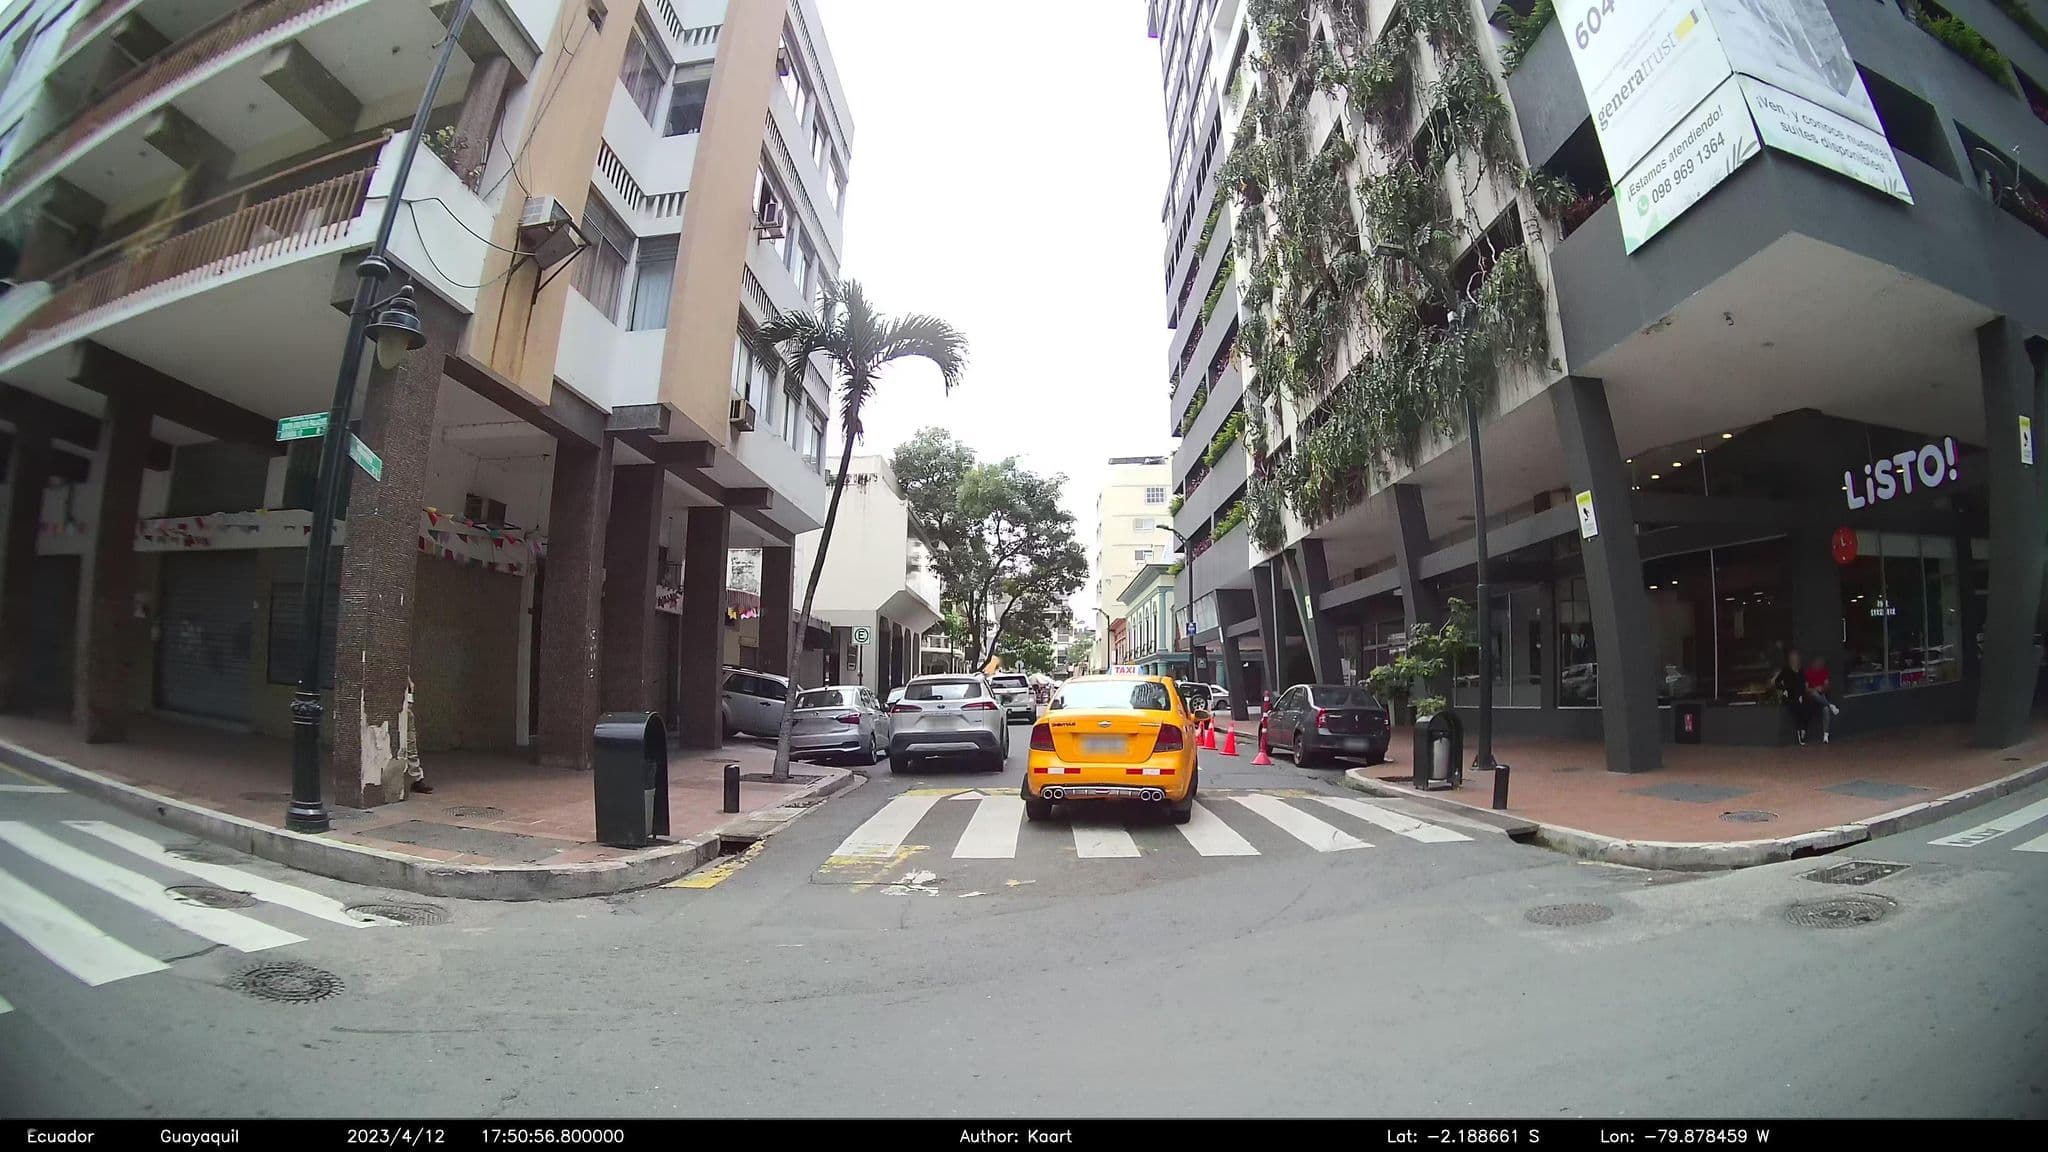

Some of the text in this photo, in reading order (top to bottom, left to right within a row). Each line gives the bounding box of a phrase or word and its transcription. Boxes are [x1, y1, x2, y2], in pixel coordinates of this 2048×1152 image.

[1598, 31, 1678, 132] generatrust
[1780, 122, 1819, 144] suites
[1792, 112, 1799, 123] y
[1802, 114, 1845, 140] conoce
[1627, 104, 1724, 203] ¡Estamos atendiendo!
[1651, 131, 1725, 204] 098 969 1364
[1114, 666, 1136, 674] TAXI
